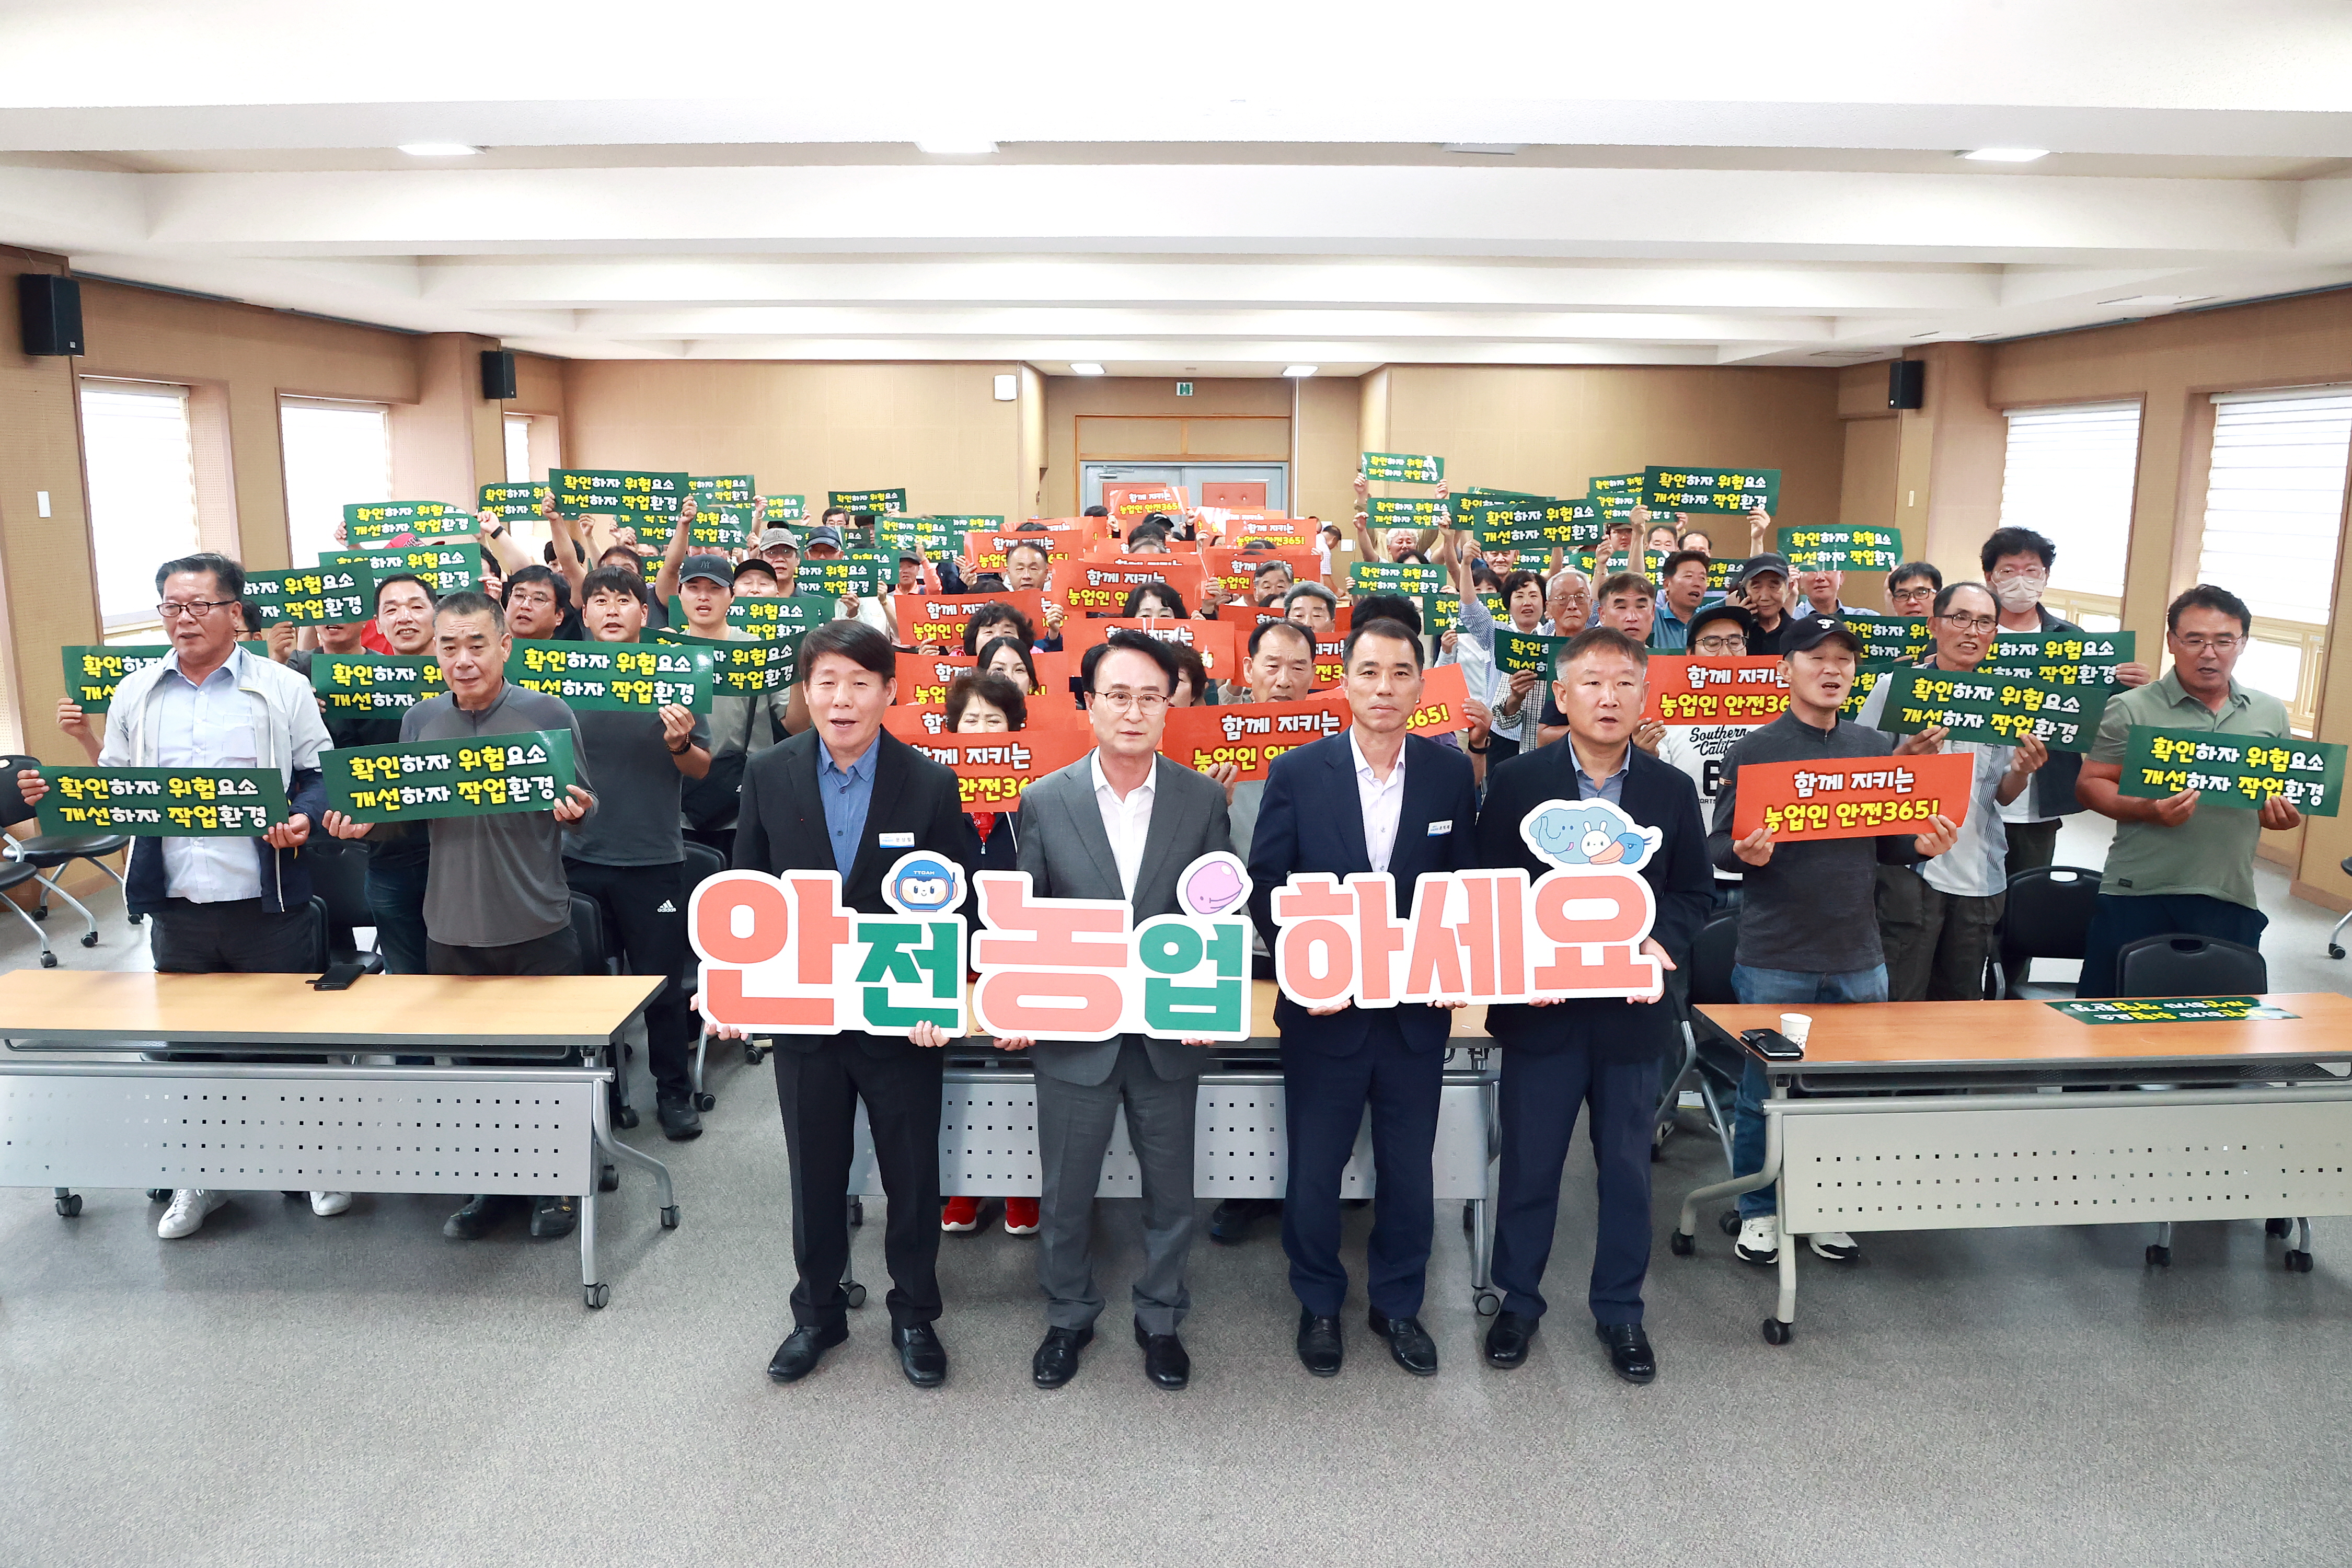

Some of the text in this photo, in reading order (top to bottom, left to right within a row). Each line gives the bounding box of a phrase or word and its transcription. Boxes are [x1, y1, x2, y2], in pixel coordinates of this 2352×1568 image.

[1370, 455, 1405, 466] 확인하자
[563, 475, 675, 492] 확인하자 위험요소
[1368, 468, 1438, 481] 개선하자 작업환경
[1595, 477, 1644, 490] 확인하자 위험
[1658, 472, 1767, 490] 확인하자 위험요소
[688, 479, 746, 491] 인하자 위험요소
[485, 487, 531, 502] 확인하자
[560, 494, 618, 508] 개선하자
[621, 495, 678, 511] 작업환경
[714, 491, 749, 502] 작업환경
[768, 498, 798, 508] 위험요소
[836, 492, 898, 503] 확인하자 위험요소
[1128, 491, 1171, 503] 함께 지키는
[1653, 492, 1767, 510] 개선하자 작업환경
[356, 507, 414, 522] 확인하자
[767, 509, 799, 518] 작업환경
[869, 502, 900, 511] 작업환경
[1120, 504, 1143, 514] 농업인
[1376, 501, 1448, 513] 확인하자 위험요소
[1486, 510, 1542, 526] 확인하자
[1546, 505, 1594, 521] 위험요소
[1603, 510, 1630, 519] 선하자
[353, 518, 469, 537] 개선하자 작업환경
[696, 512, 740, 526] 위험요소
[882, 520, 946, 533] 확인하자 위험요소
[969, 518, 997, 527] 위험요소
[1374, 515, 1411, 525] 개선하자
[1413, 515, 1445, 526] 작업환
[640, 527, 742, 543] 개선하 작업환경
[1247, 523, 1294, 534] 함께 지키는
[1483, 524, 1598, 545] 개선하자 작업환경
[881, 534, 914, 543] 개선하자
[993, 537, 1018, 551] 함께
[1792, 531, 1892, 548] 확인하자 위험요소
[407, 551, 465, 569] 위험요소
[925, 549, 958, 560] 작업환경
[1581, 556, 1629, 569] 확하자
[1789, 549, 1896, 566] 개선하자 작업환경
[795, 567, 823, 578] 하자
[825, 564, 868, 578] 위험요소
[1231, 560, 1256, 574] 함께
[1360, 566, 1437, 580] 확인하자 위험요소
[284, 572, 355, 595] 위험요소
[414, 571, 469, 590] 업환경
[1087, 569, 1166, 586] 함께 지키는
[1217, 576, 1250, 590] 농업인
[824, 580, 869, 594] 작업환경
[1358, 581, 1439, 594] 개선하자 작업환경
[1068, 588, 1110, 606] 농업인
[284, 595, 362, 621] 작업환경
[749, 604, 804, 620] 위험요소
[926, 601, 957, 620] 함께
[913, 622, 952, 641] 농업인
[731, 644, 792, 667] 위험요소
[1510, 638, 1549, 656] 확인하
[1986, 639, 2115, 660] 인하자 위험요소
[524, 648, 691, 676] 확인하자 위험요소
[1506, 658, 1548, 673] 개선하
[331, 663, 417, 687] 확인하자
[728, 663, 794, 690] 작업환경
[1687, 665, 1732, 688] 함께
[2038, 663, 2117, 685] 작업환경
[329, 691, 416, 711] 개선하자
[611, 681, 695, 706] 작업환경
[915, 685, 947, 705] 농업
[1911, 677, 1994, 702] 확인하자
[1999, 685, 2081, 713] 위험요소
[1661, 694, 1790, 717] 농업인 안전36
[1221, 711, 1340, 741] 함께 지키는
[1406, 704, 1449, 730] 365!
[1902, 708, 2079, 744] 개선하자 작업환경
[1689, 725, 1747, 742] Southern
[349, 744, 547, 781] 확인하자 위험요소
[966, 743, 1031, 769] 지키는
[1193, 747, 1256, 773] 농업인
[2151, 736, 2324, 773] 확인하자 위험요소
[57, 776, 259, 800] 확인하자 위험요소
[958, 777, 1030, 801] 안전3
[1794, 767, 1915, 798] 함께 지키는
[2142, 768, 2325, 806] 개선하자 작업환경
[350, 775, 555, 811] 개선하자 작업환경
[59, 804, 267, 829] 개선하자 작업환경
[1765, 799, 1939, 833] 농업인 안전365!
[1279, 874, 1653, 1000] 하세요
